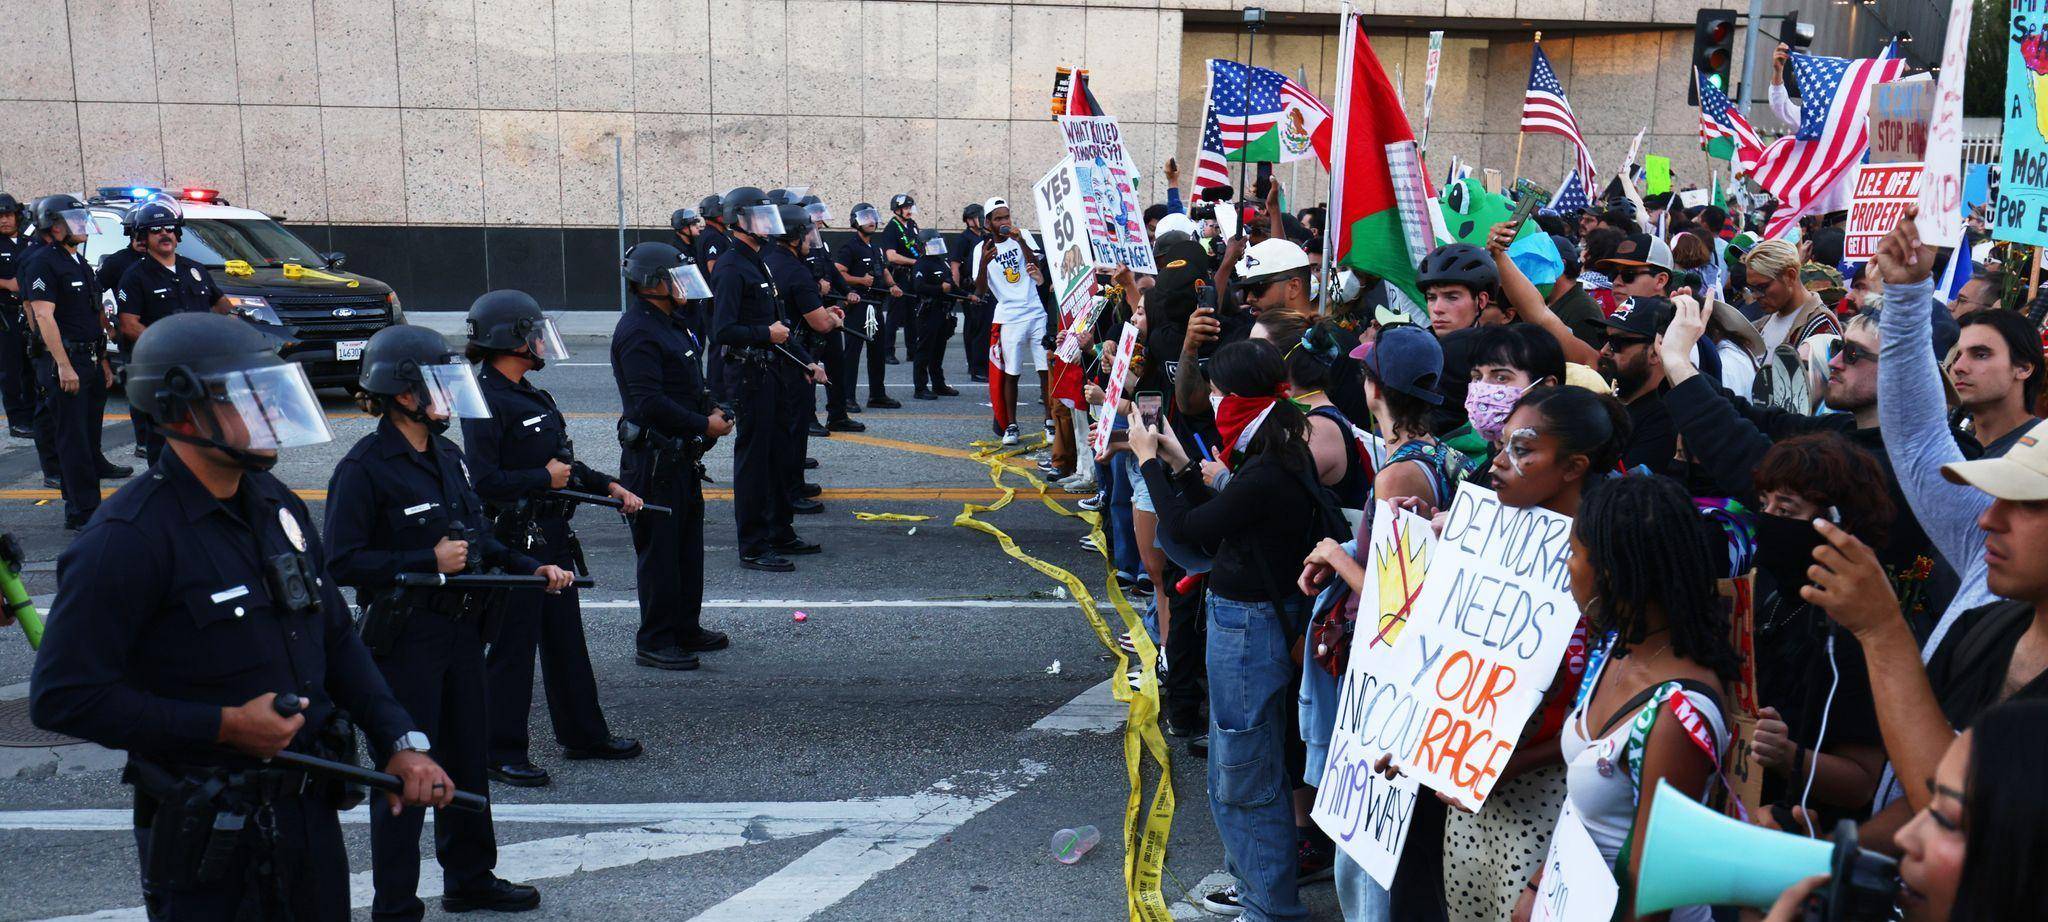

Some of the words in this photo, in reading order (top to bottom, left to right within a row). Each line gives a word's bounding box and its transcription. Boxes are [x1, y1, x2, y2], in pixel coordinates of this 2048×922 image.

[2012, 95, 2022, 119] A
[1063, 121, 1089, 145] WHAT
[1089, 121, 1118, 145] KILLED
[1878, 121, 1903, 152] STOP
[1884, 171, 1912, 196] OFF
[2011, 148, 2048, 188] MOR
[1041, 167, 1070, 211] YES
[1850, 202, 1918, 232] PROPERT
[1997, 195, 2026, 228] POR
[1054, 211, 1074, 251] 50
[994, 248, 1019, 263] WHAT
[1000, 257, 1019, 269] THE
[1092, 239, 1113, 263] THE
[1438, 568, 1555, 660] NEEDS
[1412, 634, 1516, 727] YOUR
[1361, 683, 1513, 801] COURAGE
[1365, 775, 1417, 855] WAY
